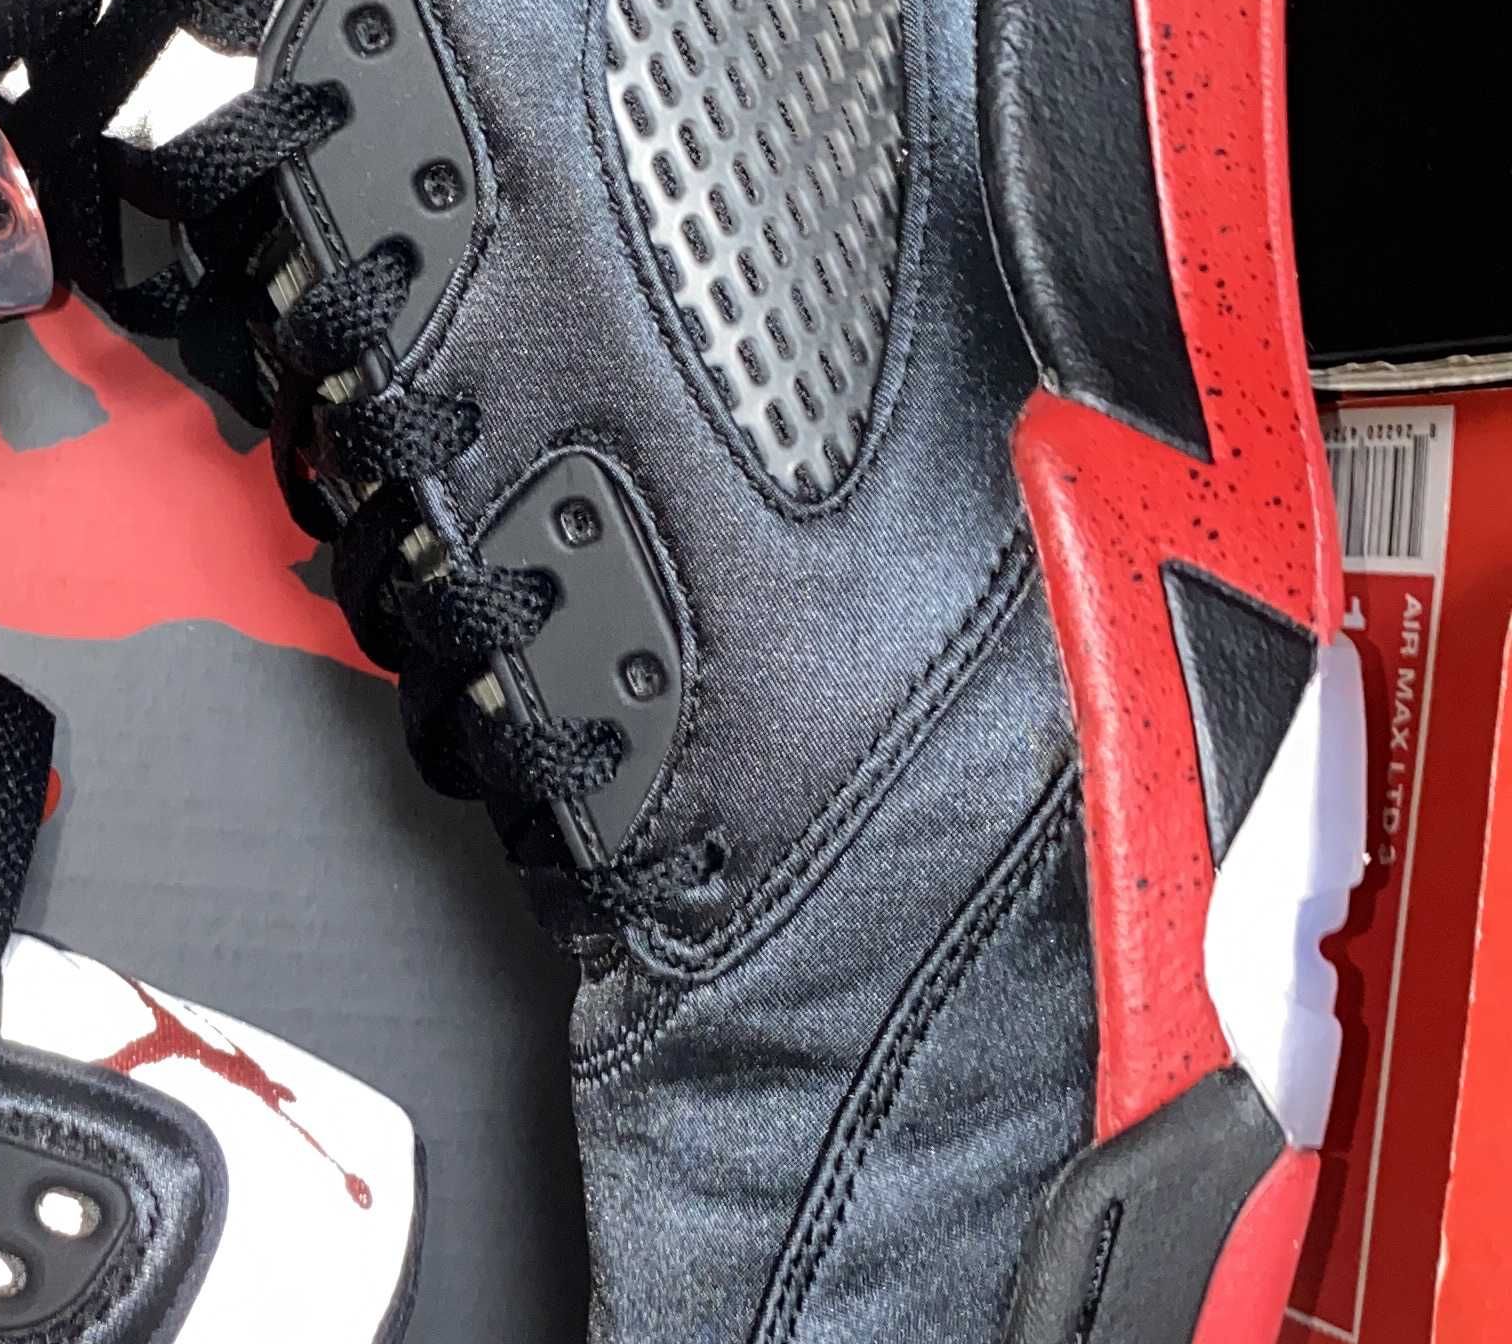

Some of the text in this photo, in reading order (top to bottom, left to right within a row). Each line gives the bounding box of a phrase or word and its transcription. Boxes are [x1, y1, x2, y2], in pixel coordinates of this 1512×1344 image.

[1377, 592, 1423, 865] AIR MAX LTD 3
